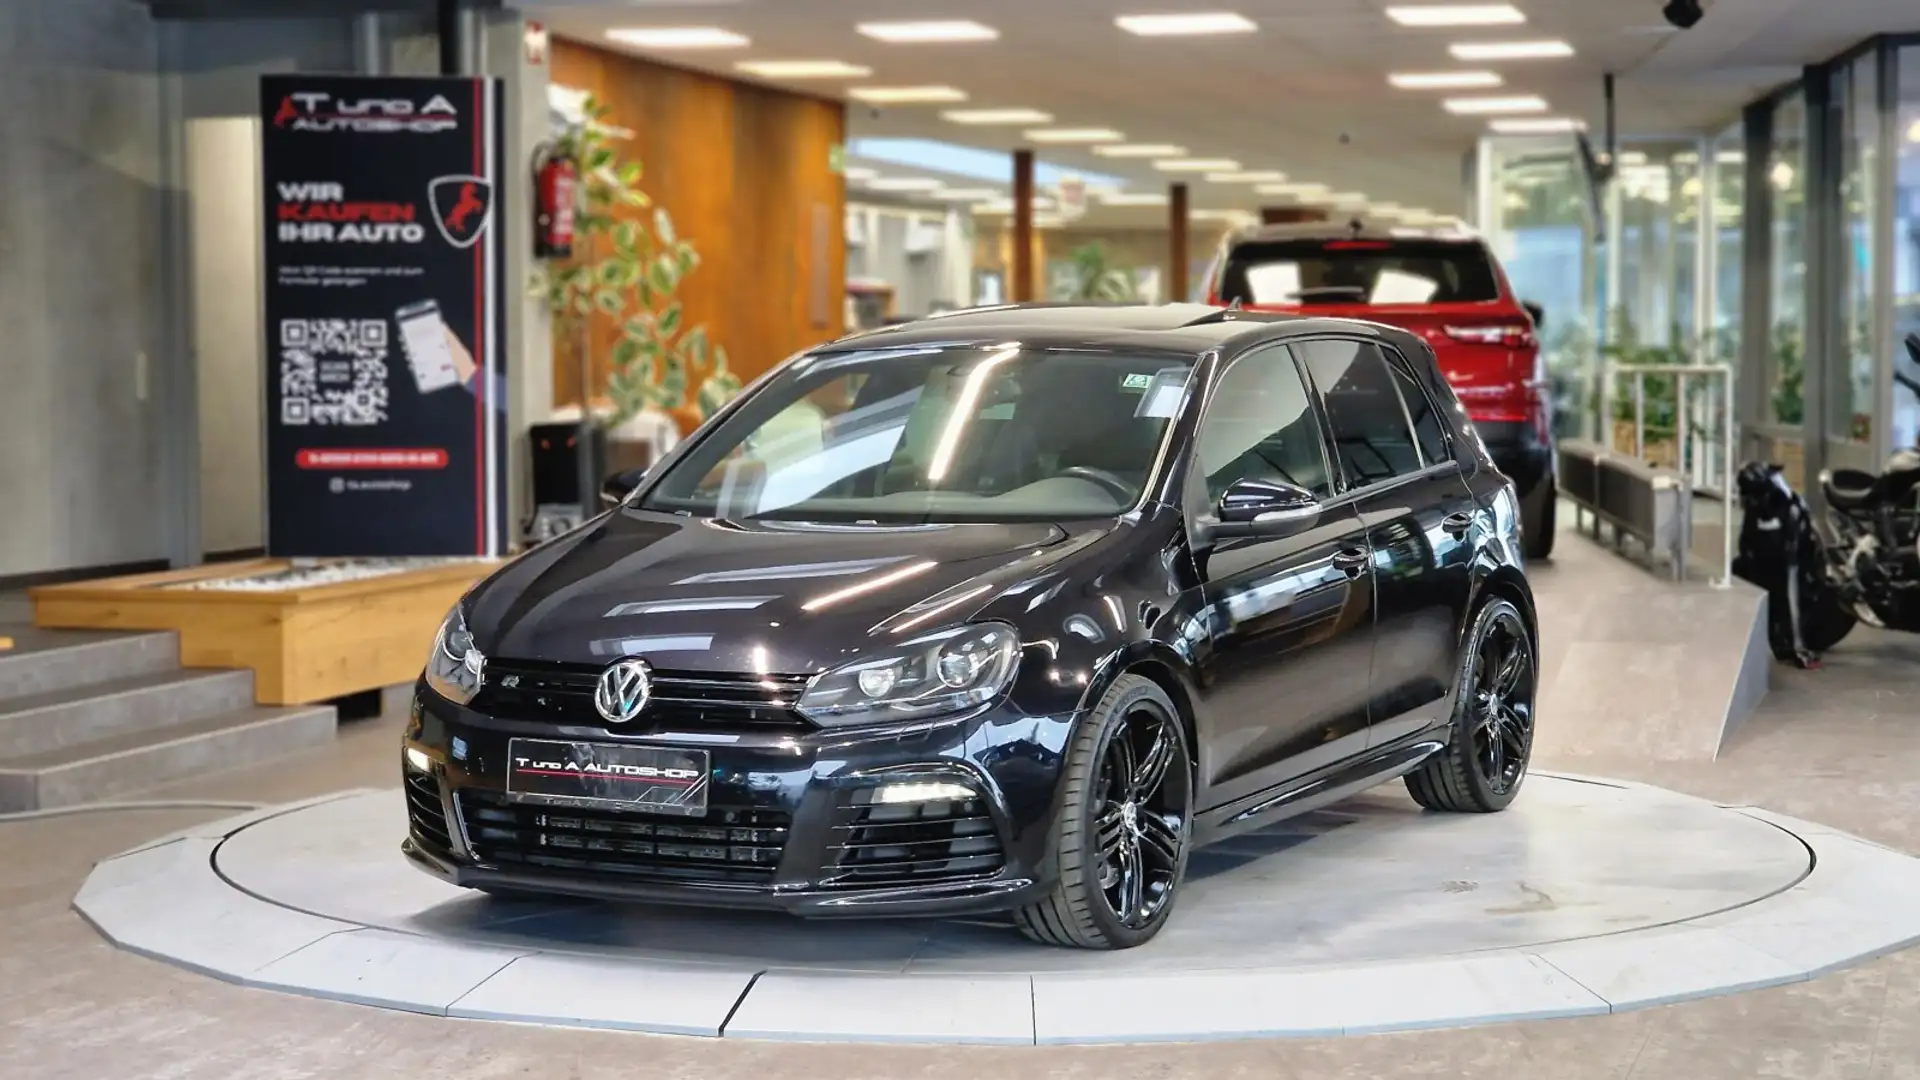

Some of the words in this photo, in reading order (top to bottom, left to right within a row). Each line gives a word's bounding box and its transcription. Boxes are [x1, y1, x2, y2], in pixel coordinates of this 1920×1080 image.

[420, 94, 457, 115] A
[277, 181, 344, 202] WIR
[277, 202, 416, 222] KAUFEN
[278, 222, 335, 243] IHR
[337, 222, 425, 243] AUTO
[515, 758, 530, 767] T
[564, 762, 580, 771] A
[584, 763, 699, 779] AUTOSHOP
